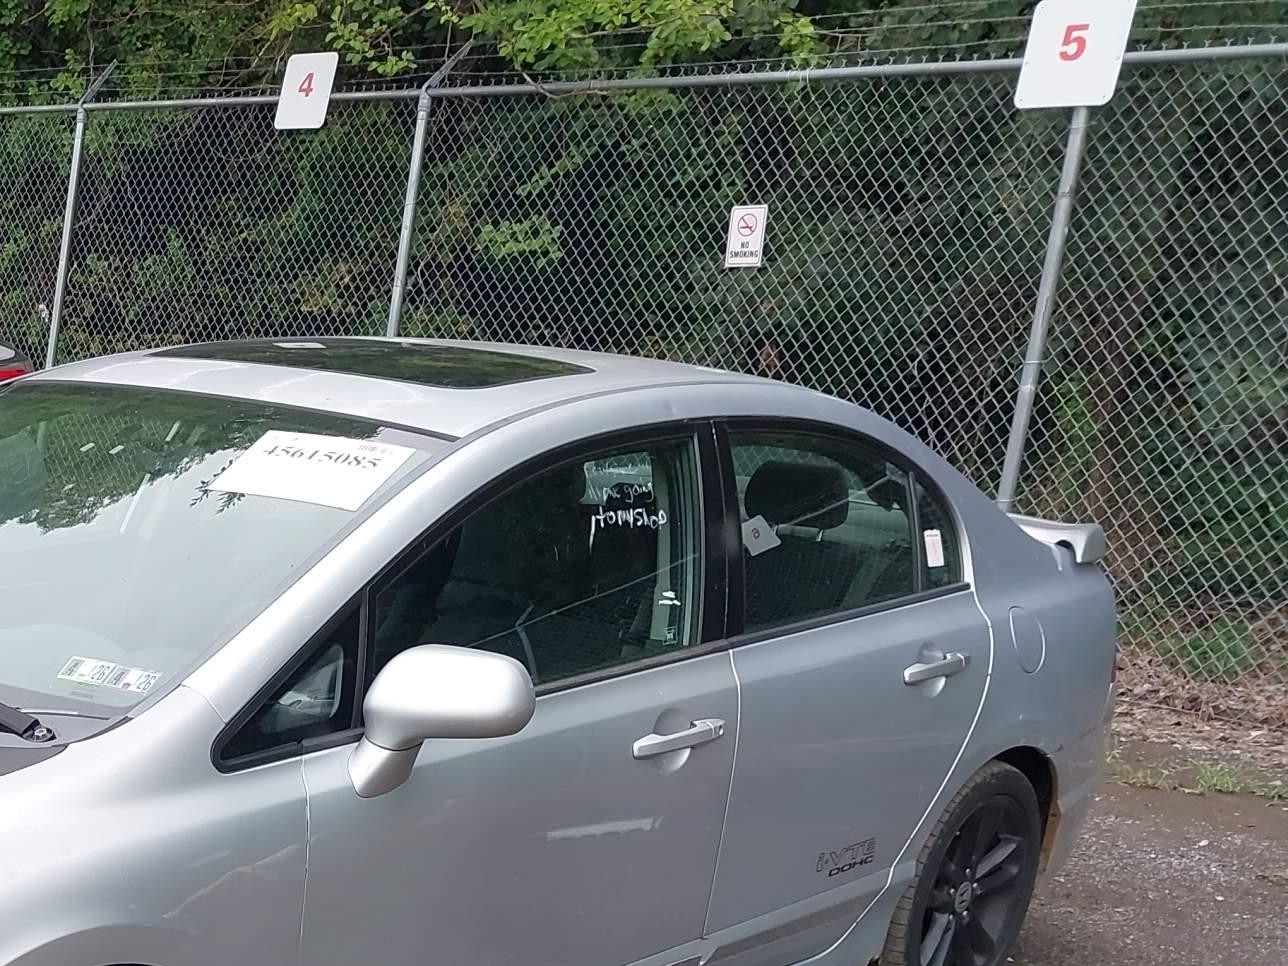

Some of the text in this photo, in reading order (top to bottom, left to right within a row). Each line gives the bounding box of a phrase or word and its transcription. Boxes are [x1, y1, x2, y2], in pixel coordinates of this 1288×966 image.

[1059, 23, 1090, 61] 5
[298, 72, 314, 97] 4
[730, 250, 759, 258] SMOKING
[740, 241, 750, 249] NO
[263, 445, 382, 469] 45615085
[623, 481, 654, 503] going
[828, 855, 874, 877] DOHC
